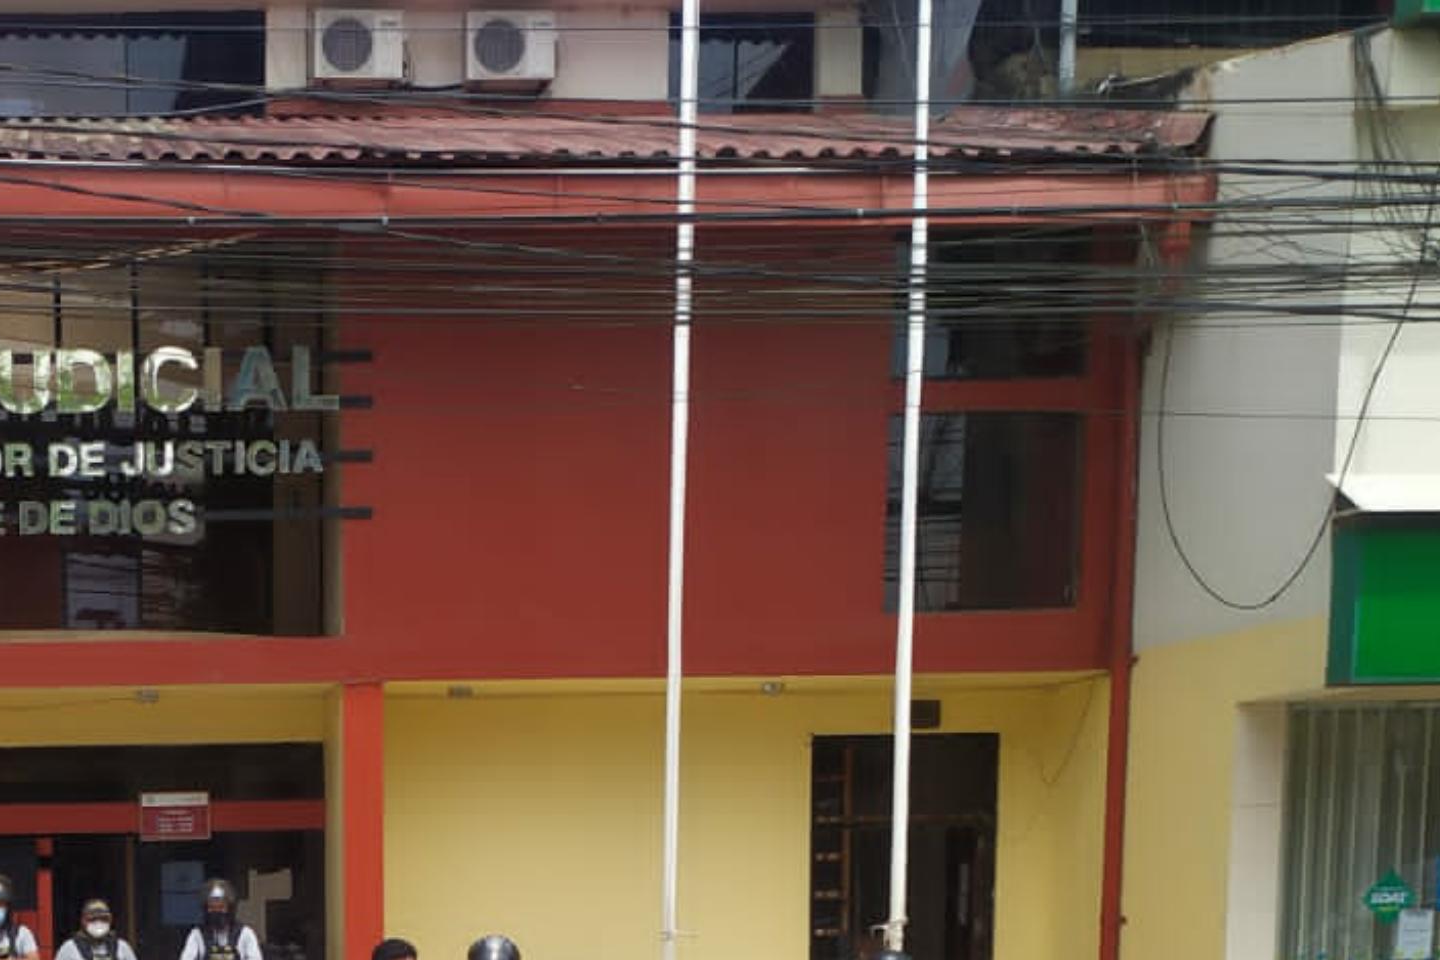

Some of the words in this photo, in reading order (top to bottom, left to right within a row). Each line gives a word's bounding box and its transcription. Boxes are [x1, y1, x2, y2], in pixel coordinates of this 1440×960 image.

[48, 442, 106, 478] DE
[121, 439, 324, 478] JUSTICIA
[19, 501, 76, 536] DE
[89, 499, 197, 535] DIOS
